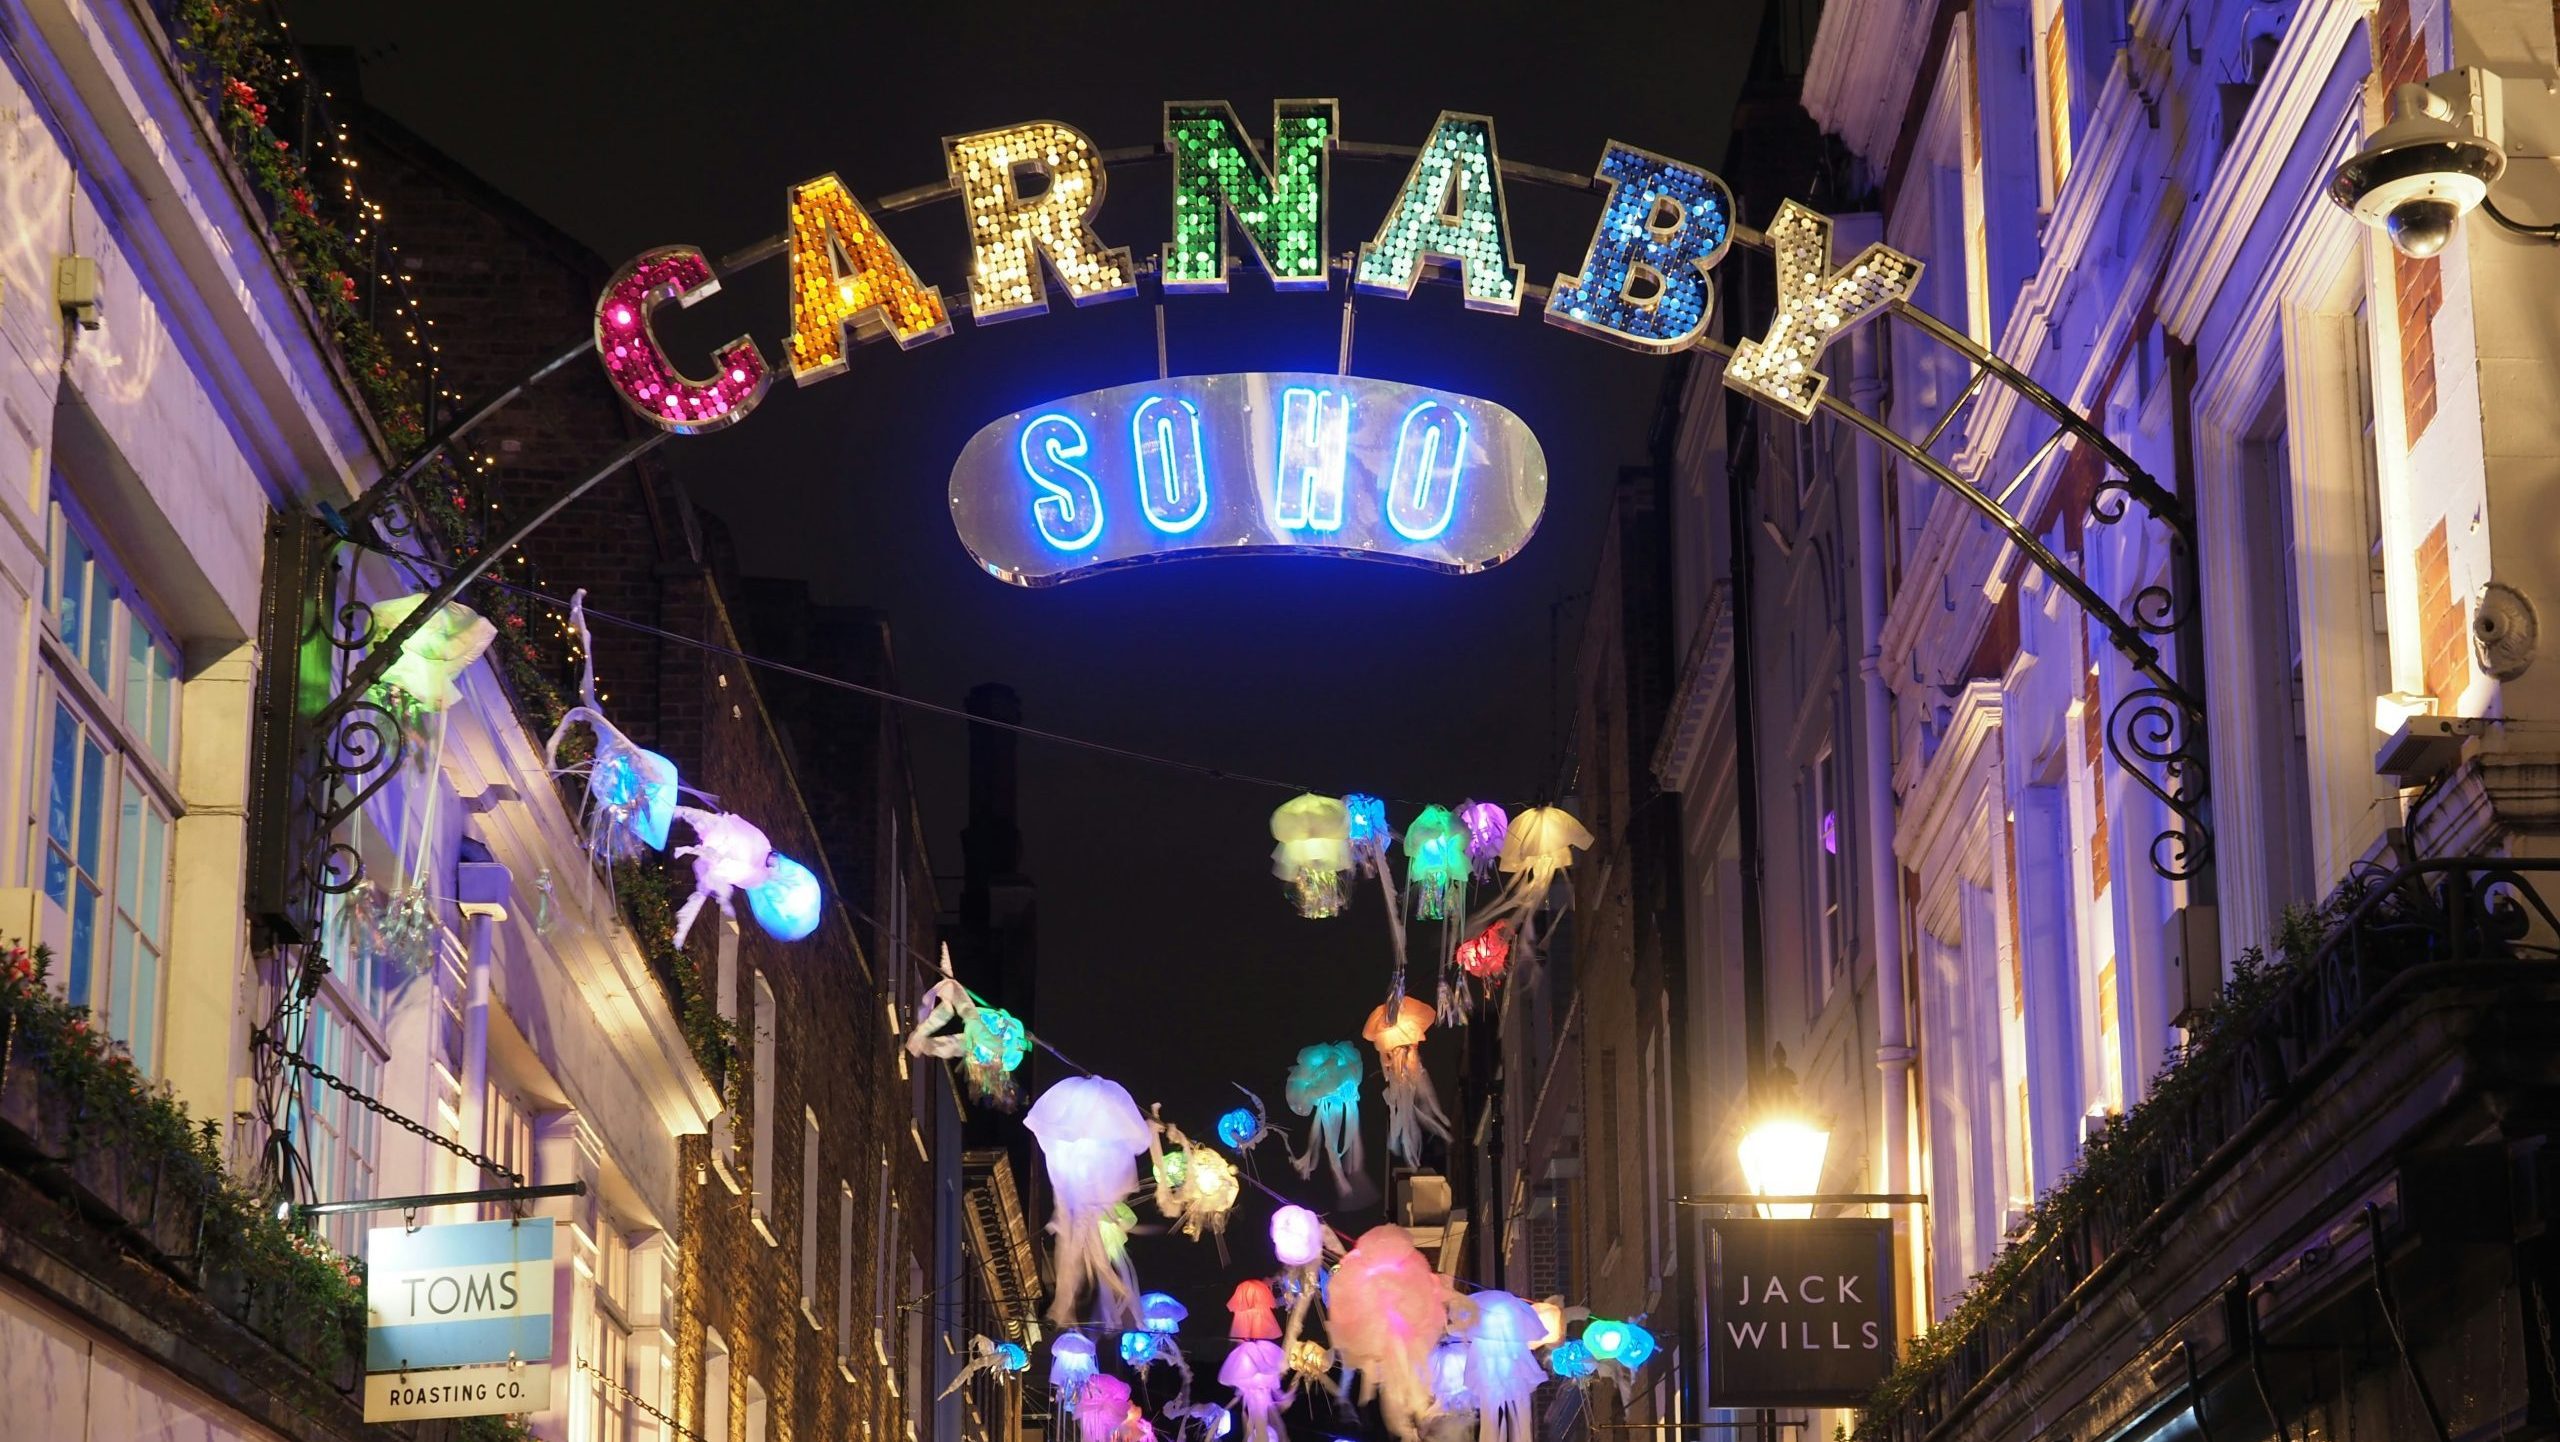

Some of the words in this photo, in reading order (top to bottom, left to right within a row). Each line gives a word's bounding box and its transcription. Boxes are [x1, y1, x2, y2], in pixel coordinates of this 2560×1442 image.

[594, 98, 1926, 435] CARNABY
[1019, 387, 1470, 551] SOHO
[401, 1270, 519, 1317] TOMS
[1738, 1275, 1863, 1306] JACK
[1726, 1321, 1879, 1350] WILLS
[389, 1383, 487, 1407] ROASTING
[496, 1381, 526, 1400] CO.
